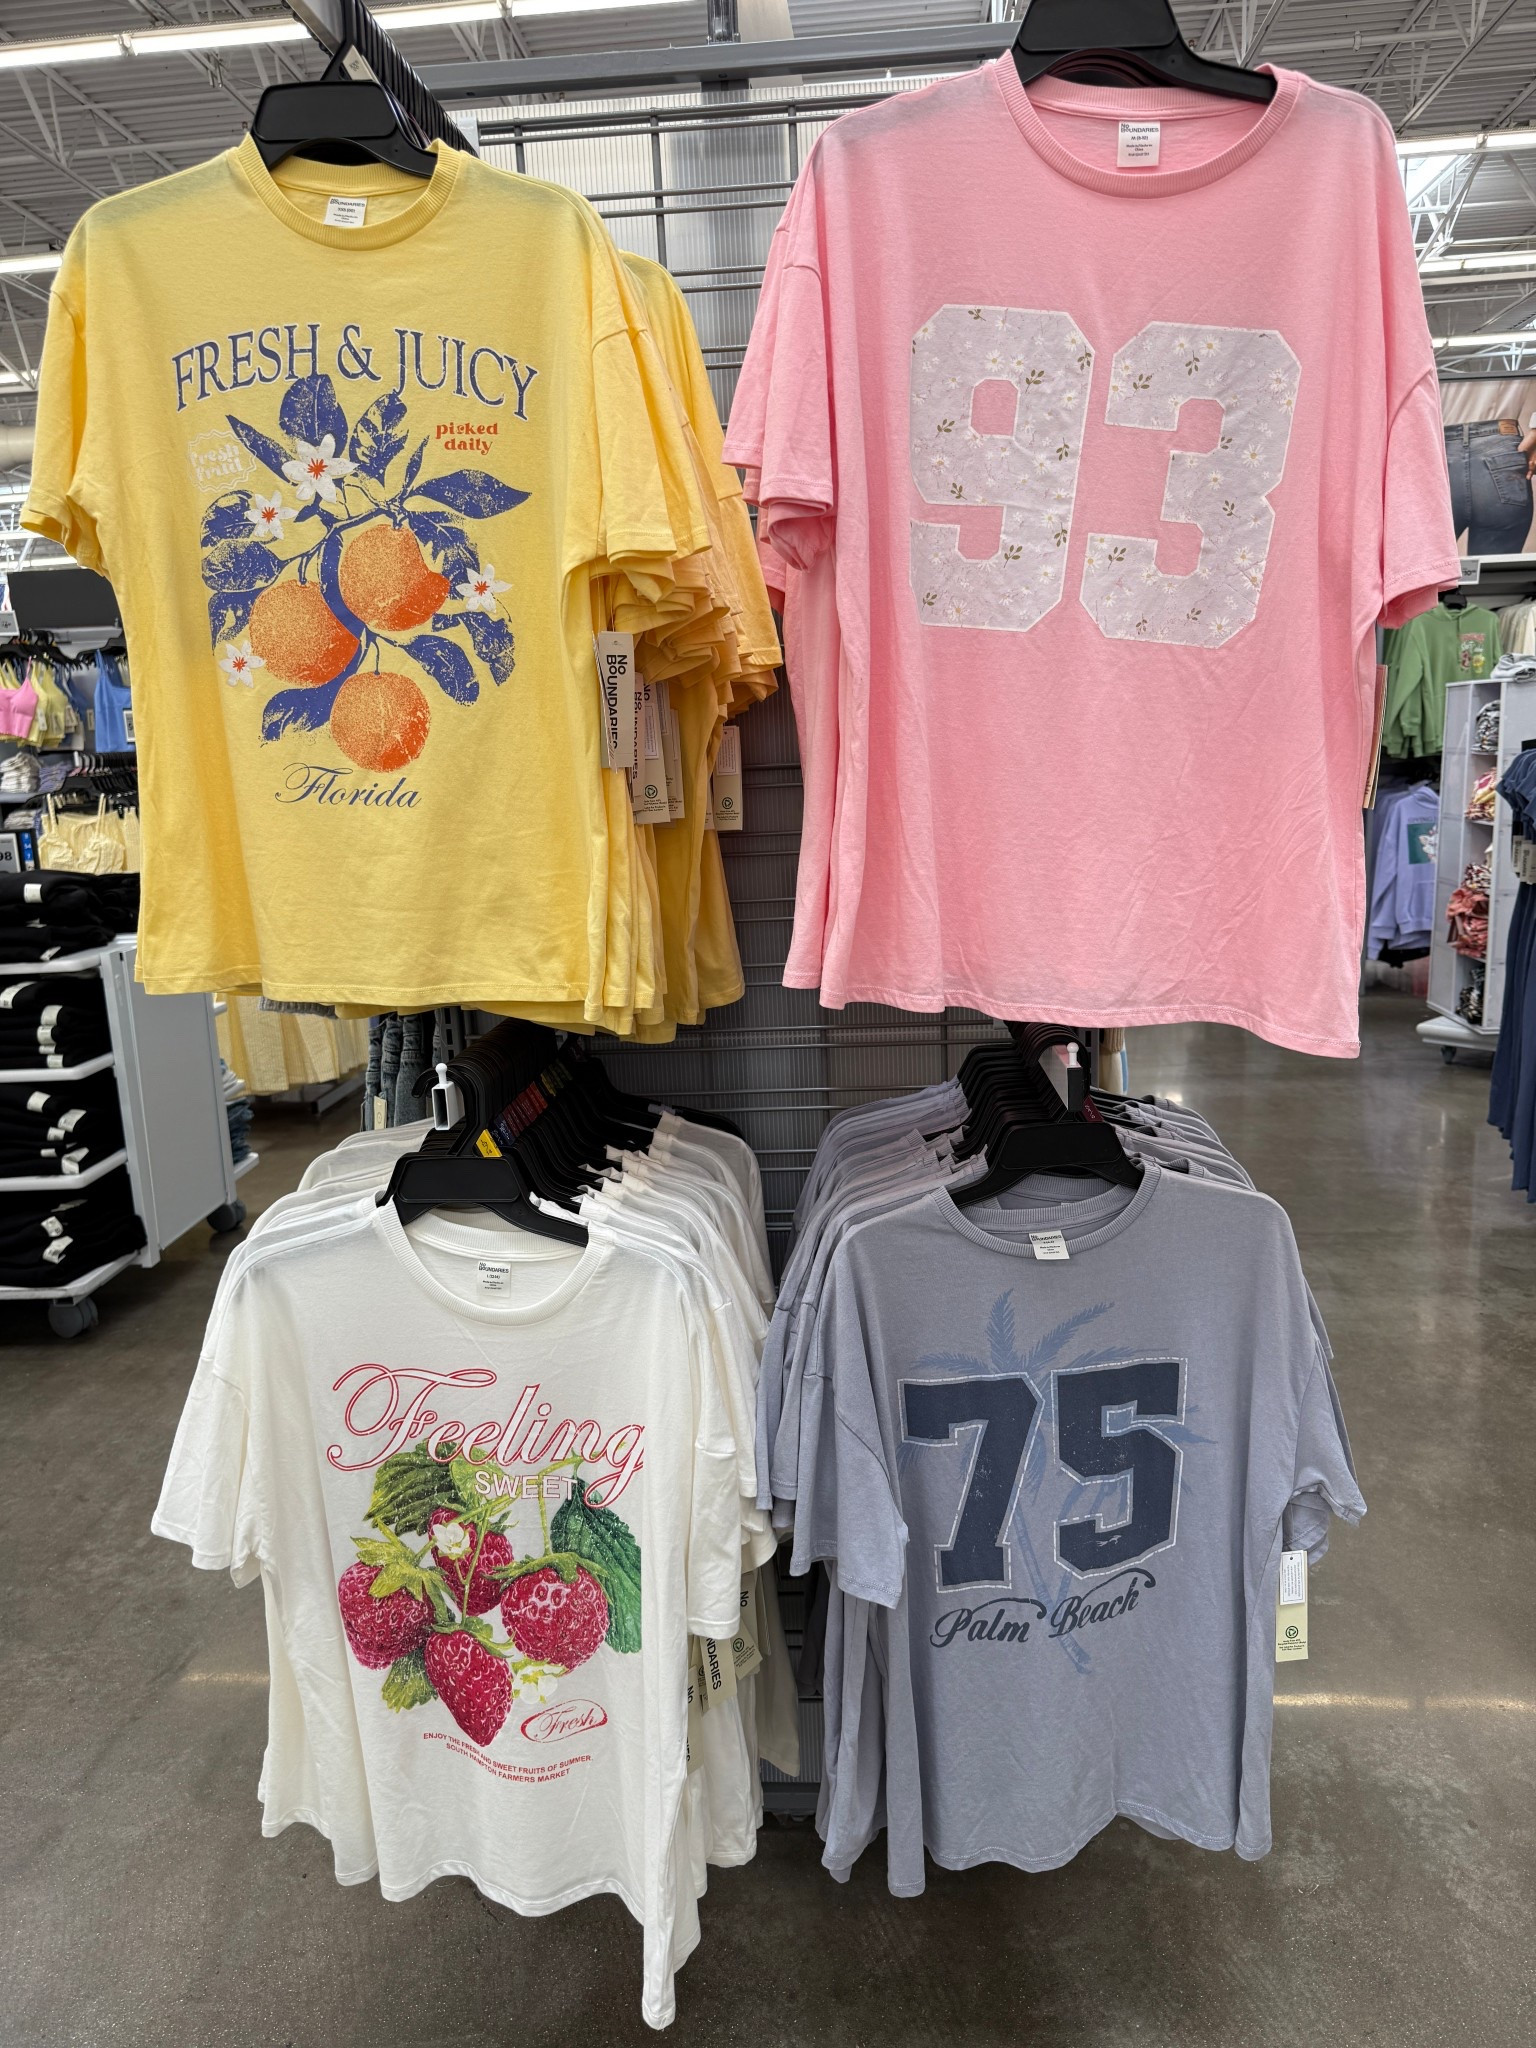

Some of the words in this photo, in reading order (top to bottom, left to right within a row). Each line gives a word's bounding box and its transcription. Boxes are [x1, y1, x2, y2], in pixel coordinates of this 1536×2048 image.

[171, 323, 321, 413] FRESH
[336, 323, 382, 382] &
[394, 327, 539, 421] JUICY
[435, 421, 498, 439] picked
[444, 438, 493, 455] daily
[908, 303, 1302, 650] 93
[274, 762, 422, 808] Florida
[326, 1363, 646, 1508] Feeling
[474, 1470, 578, 1500] SWEET
[897, 1357, 1188, 1593] 75
[929, 1597, 1047, 1648] Palm
[1048, 1567, 1156, 1638] Beach
[706, 1638, 722, 1690] NDARIES
[534, 1705, 598, 1741] Fresh
[423, 1732, 448, 1741] ENJOY
[448, 1735, 461, 1747] THE
[461, 1741, 480, 1756] FRESH
[480, 1751, 492, 1766] AND
[492, 1760, 517, 1773] SWEET
[518, 1766, 546, 1775] FRUITS
[547, 1763, 559, 1772] OF
[446, 1742, 469, 1757] SOUTH
[469, 1753, 497, 1776] HAMPTON
[498, 1771, 536, 1783] FARMERS
[537, 1768, 571, 1783] MARKET
